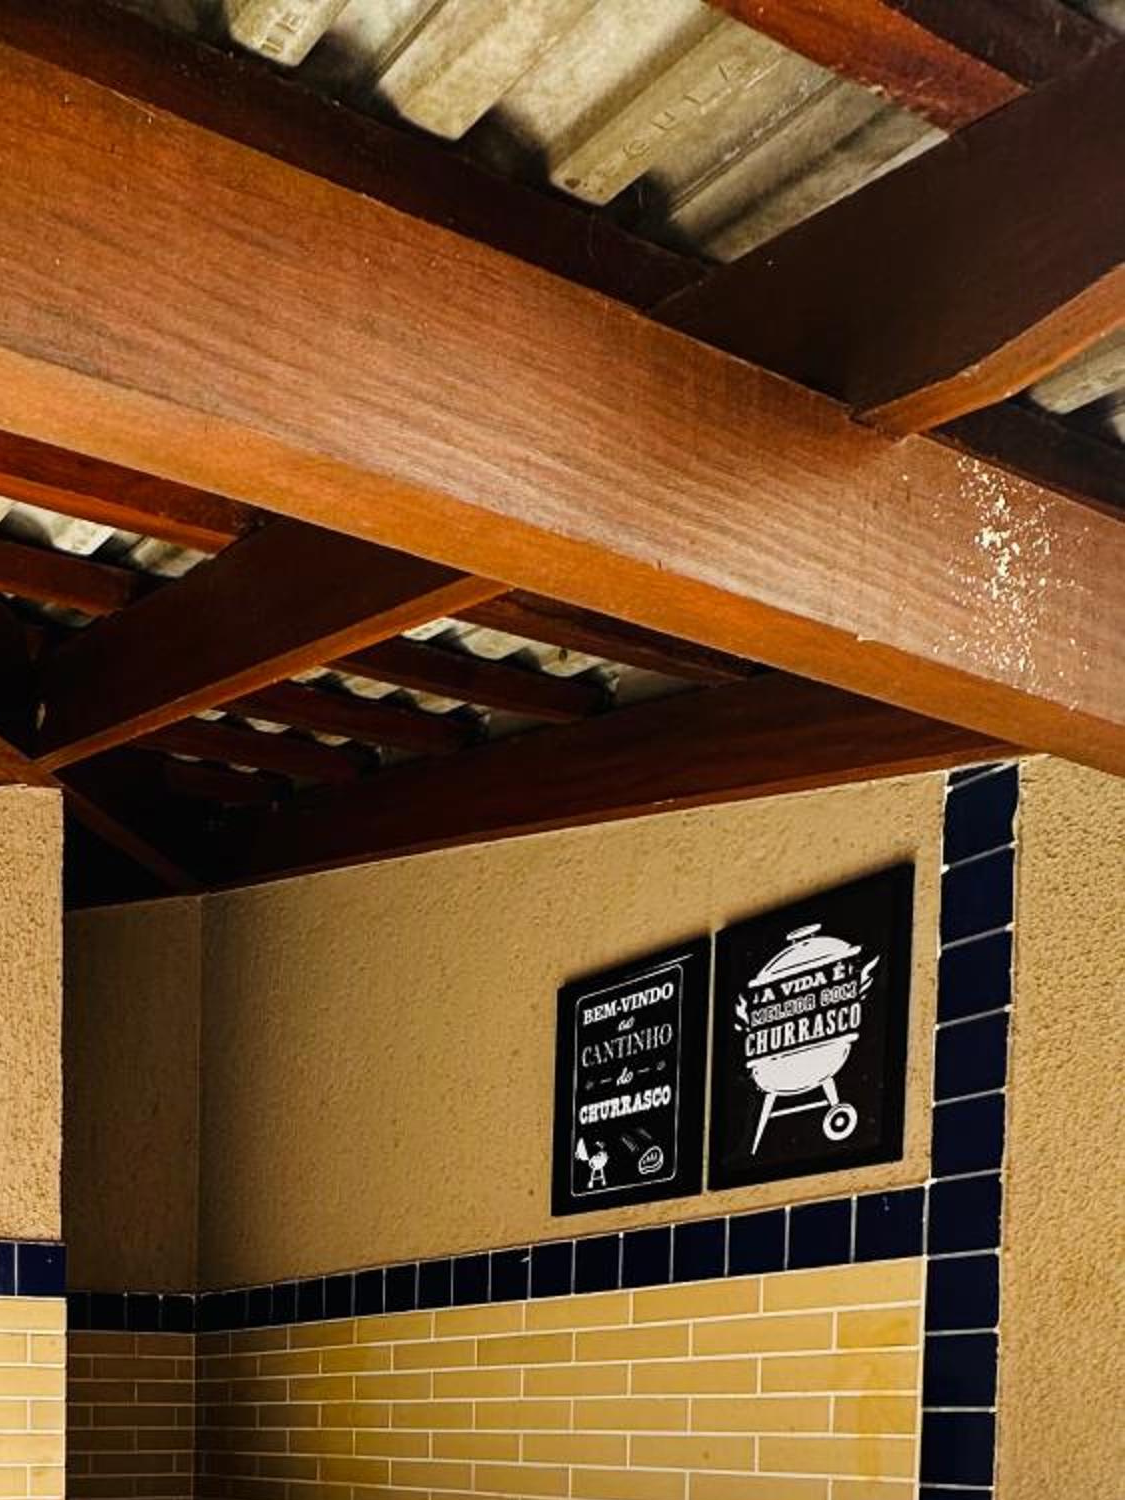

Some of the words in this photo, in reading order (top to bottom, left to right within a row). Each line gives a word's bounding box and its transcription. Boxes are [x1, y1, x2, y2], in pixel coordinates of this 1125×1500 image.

[583, 982, 673, 1025] BEM-VINDO
[751, 994, 816, 1027] MELHOR
[820, 980, 857, 1006] COM
[761, 988, 775, 1002] A
[781, 971, 827, 996] VIDA
[833, 962, 845, 981] É
[581, 1024, 672, 1067] CANTINHO
[745, 1003, 861, 1056] CHURRASCO
[616, 1067, 634, 1085] do
[579, 1085, 671, 1125] CHURRASCO
